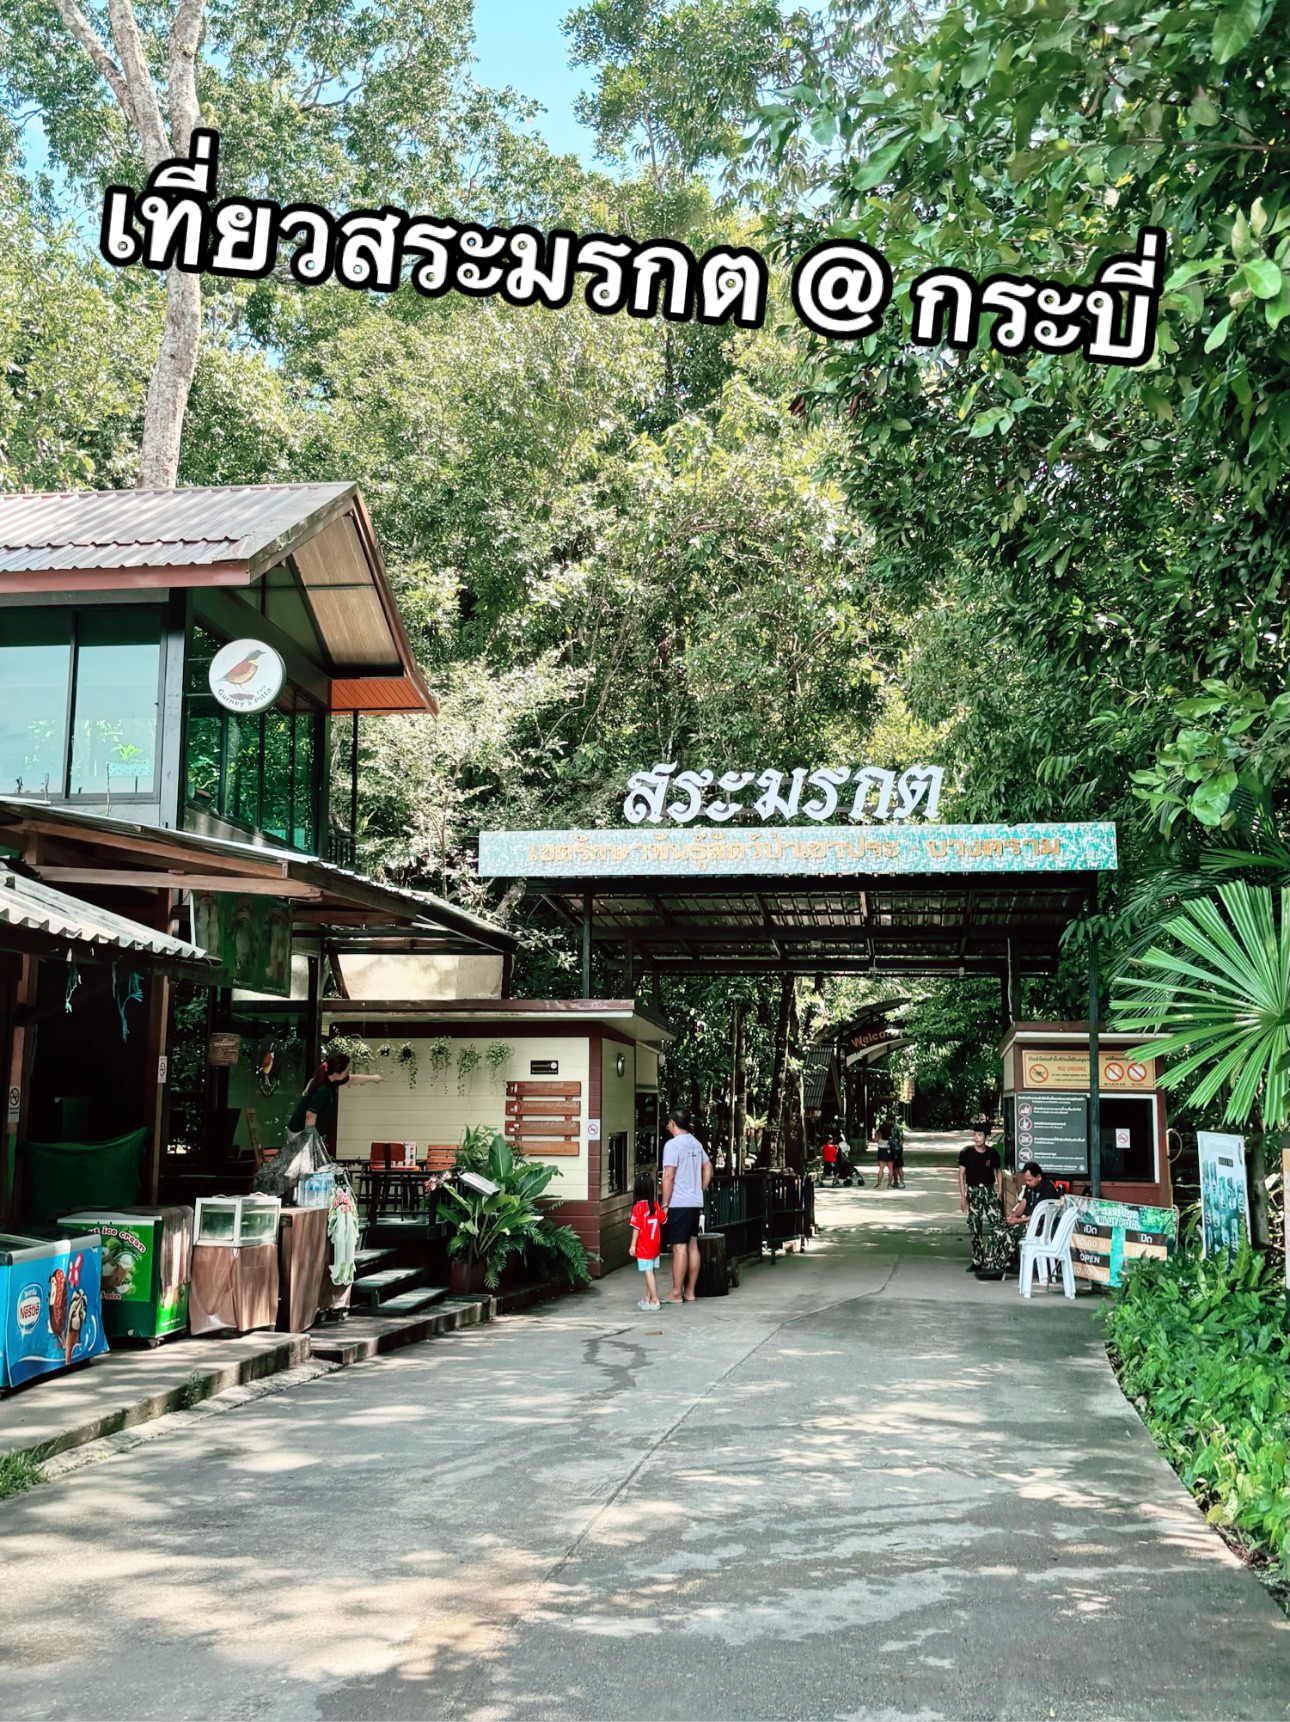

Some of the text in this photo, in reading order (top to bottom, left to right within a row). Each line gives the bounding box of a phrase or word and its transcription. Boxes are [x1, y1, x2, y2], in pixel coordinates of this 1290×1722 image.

[217, 687, 272, 707] Gurney's Pitta
[622, 760, 946, 825] สระมรกต
[925, 836, 1063, 858] บางคราม
[850, 1030, 890, 1047] Welco
[102, 1226, 118, 1236] ice
[647, 1218, 658, 1240] 7
[1079, 1253, 1100, 1264] OPEN
